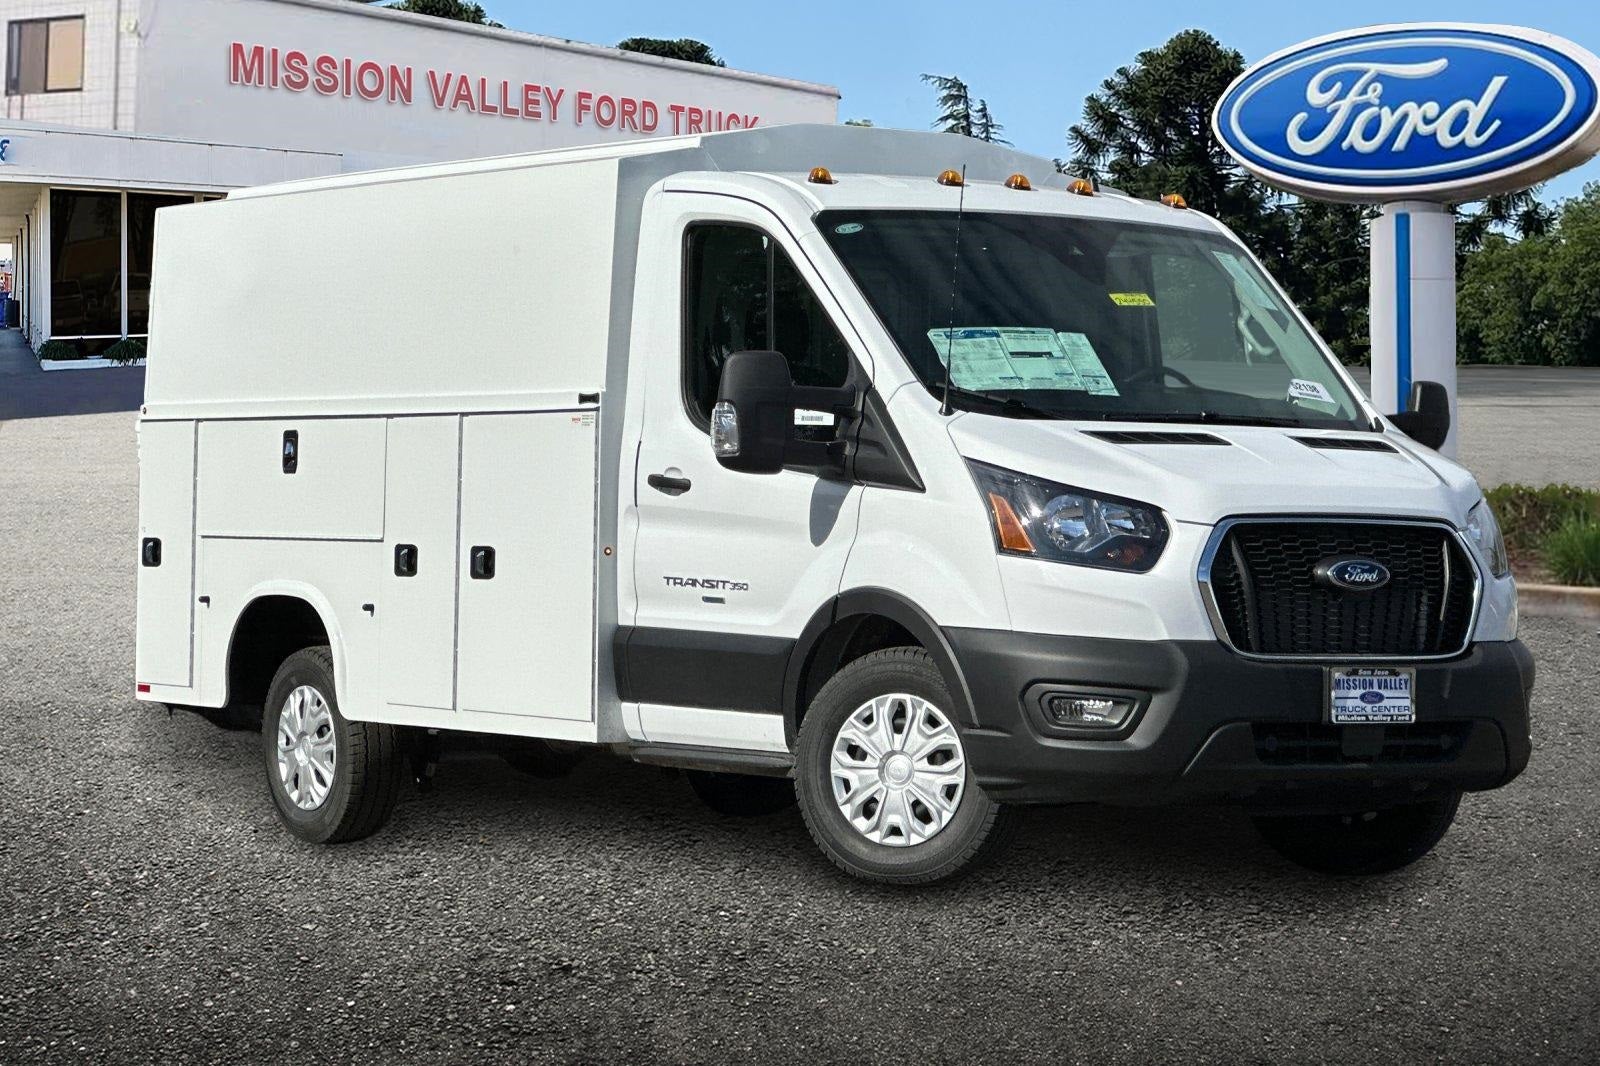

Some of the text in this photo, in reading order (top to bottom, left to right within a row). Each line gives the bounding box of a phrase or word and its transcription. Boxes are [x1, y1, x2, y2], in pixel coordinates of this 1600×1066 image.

[230, 41, 413, 105] MISSION
[428, 69, 565, 122] VALLEY
[575, 90, 660, 134] FORD
[1286, 57, 1508, 156] Ford
[1345, 564, 1379, 582] Ford
[1335, 678, 1409, 690] MISSION VALLEY
[1335, 705, 1410, 713] TRUCK CENTER
